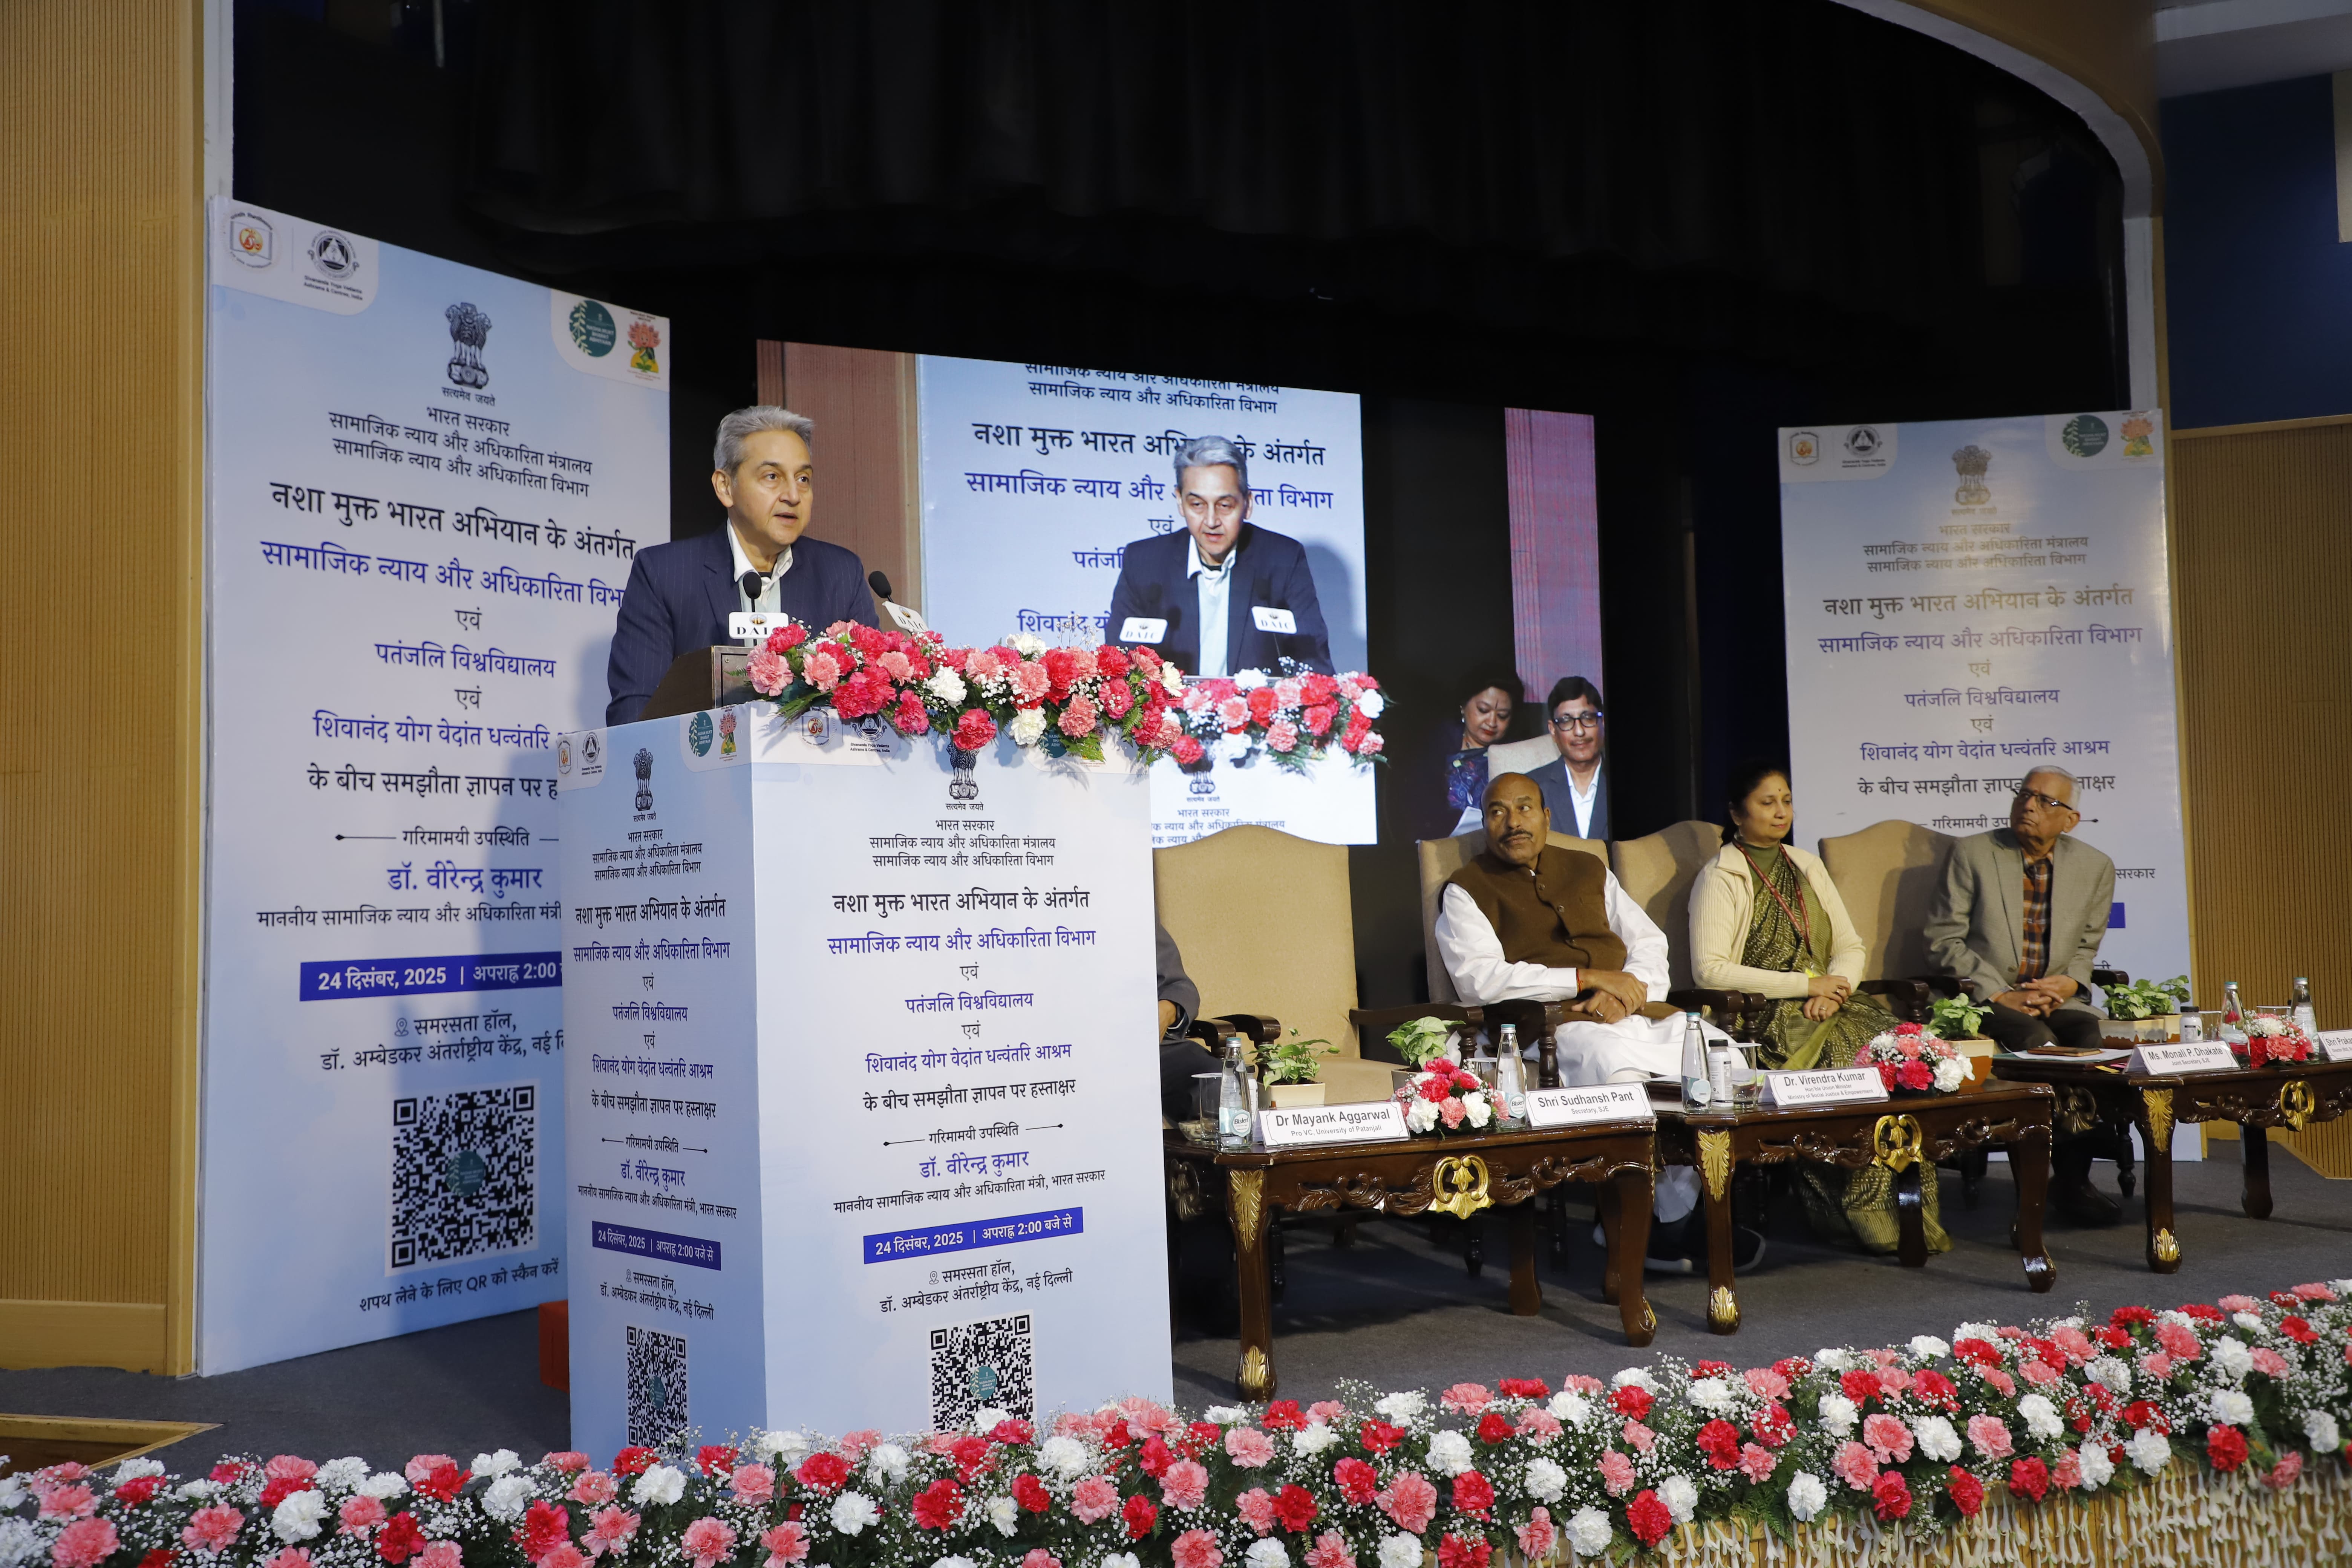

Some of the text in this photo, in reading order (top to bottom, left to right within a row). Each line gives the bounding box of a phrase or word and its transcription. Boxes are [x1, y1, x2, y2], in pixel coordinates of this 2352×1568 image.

[1028, 381, 1277, 413] सामाजिक न्याय और अधिकारिता विभाग
[427, 407, 510, 436] भारत सरकार
[972, 424, 1136, 455] नशा मुक्त भारत
[270, 482, 636, 560] नशा मुक्त भारत अभियान के अंतर्गत
[1860, 738, 2110, 761] शिवानंद योग वेदांत धन्वंतरि आश्रम
[946, 801, 966, 810] सत्यमेव
[936, 820, 994, 830] भारत सरकार
[869, 833, 1056, 848] सामाजिक न्याय और अधिकारिता मंत्रालय
[873, 851, 1054, 866] सामाजिक न्याय और अधिकारिता विभाग
[832, 886, 1090, 918] नशा मुक्त भारत अभियान के अंतर्गत
[827, 926, 1096, 954] सामाजिक न्याय और अधिकारिता विभाग
[960, 962, 979, 980] एवं
[905, 990, 1034, 1013] पतंजलि विश्वविद्यालय
[962, 1020, 981, 1039] एवं
[2148, 1047, 2223, 1060] Ms. Monali P. Dhakate
[2325, 1038, 2338, 1046] Shri
[865, 1043, 1072, 1073] शिवानंद योग वेदांत धन्वंतरि आश्रम
[1784, 1072, 1865, 1086] Dr. Virendra Kumar
[863, 1080, 1076, 1111] के बीच समझौता ज्ञापन पर हस्ताक्षर
[1538, 1091, 1634, 1107] Shri Sudhansh Pant
[1276, 1109, 1390, 1127] Dr Mayank Aggarwal
[929, 1122, 1018, 1143] गरिमामयी उपस्थिति
[919, 1152, 1029, 1178] डॉ. वीरेन्द्र कुमार
[833, 1170, 1105, 1213] माननीय सामाजिक न्याय और अधिकारिता मंत्री, भारत सरकार
[876, 1242, 891, 1255] 24
[893, 1236, 930, 1253] दिसंबर,
[934, 1231, 963, 1246] 2025
[1018, 1221, 1041, 1235] 2:00
[1044, 1215, 1060, 1230] बजे
[1062, 1214, 1072, 1228] से
[942, 1259, 1014, 1282] समरसता हॉल,
[360, 1258, 558, 1311] शपथ लेने के लिए QR को स्कैन करें
[880, 1268, 1072, 1312] डॉ. अम्बेडकर अंतर्राष्ट्रीय केंद्र, नई दिल्ली
